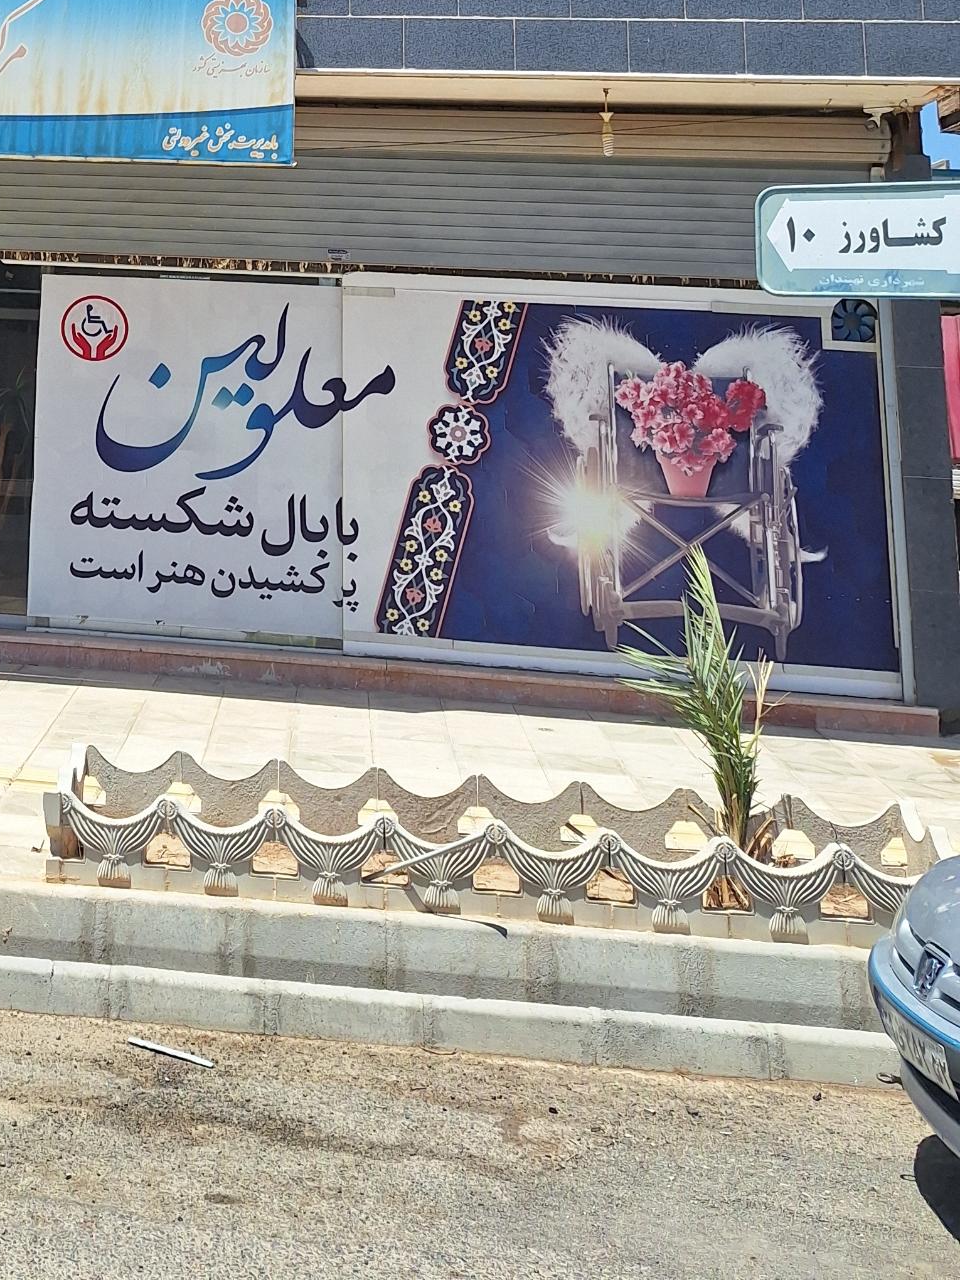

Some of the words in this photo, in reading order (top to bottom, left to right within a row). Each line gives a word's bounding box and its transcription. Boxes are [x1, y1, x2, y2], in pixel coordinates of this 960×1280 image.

[192, 53, 215, 73] کشور
[245, 61, 271, 77] سازمان
[786, 216, 816, 253] ۱۰
[838, 216, 947, 254] کشاورز
[867, 275, 925, 288] شهرداری
[95, 302, 396, 481] معلولین
[70, 486, 254, 537] شکسته
[260, 493, 330, 560] بال
[335, 496, 360, 562] با
[69, 550, 144, 582] است
[146, 560, 206, 593] هنر
[211, 562, 330, 600] کشیدن
